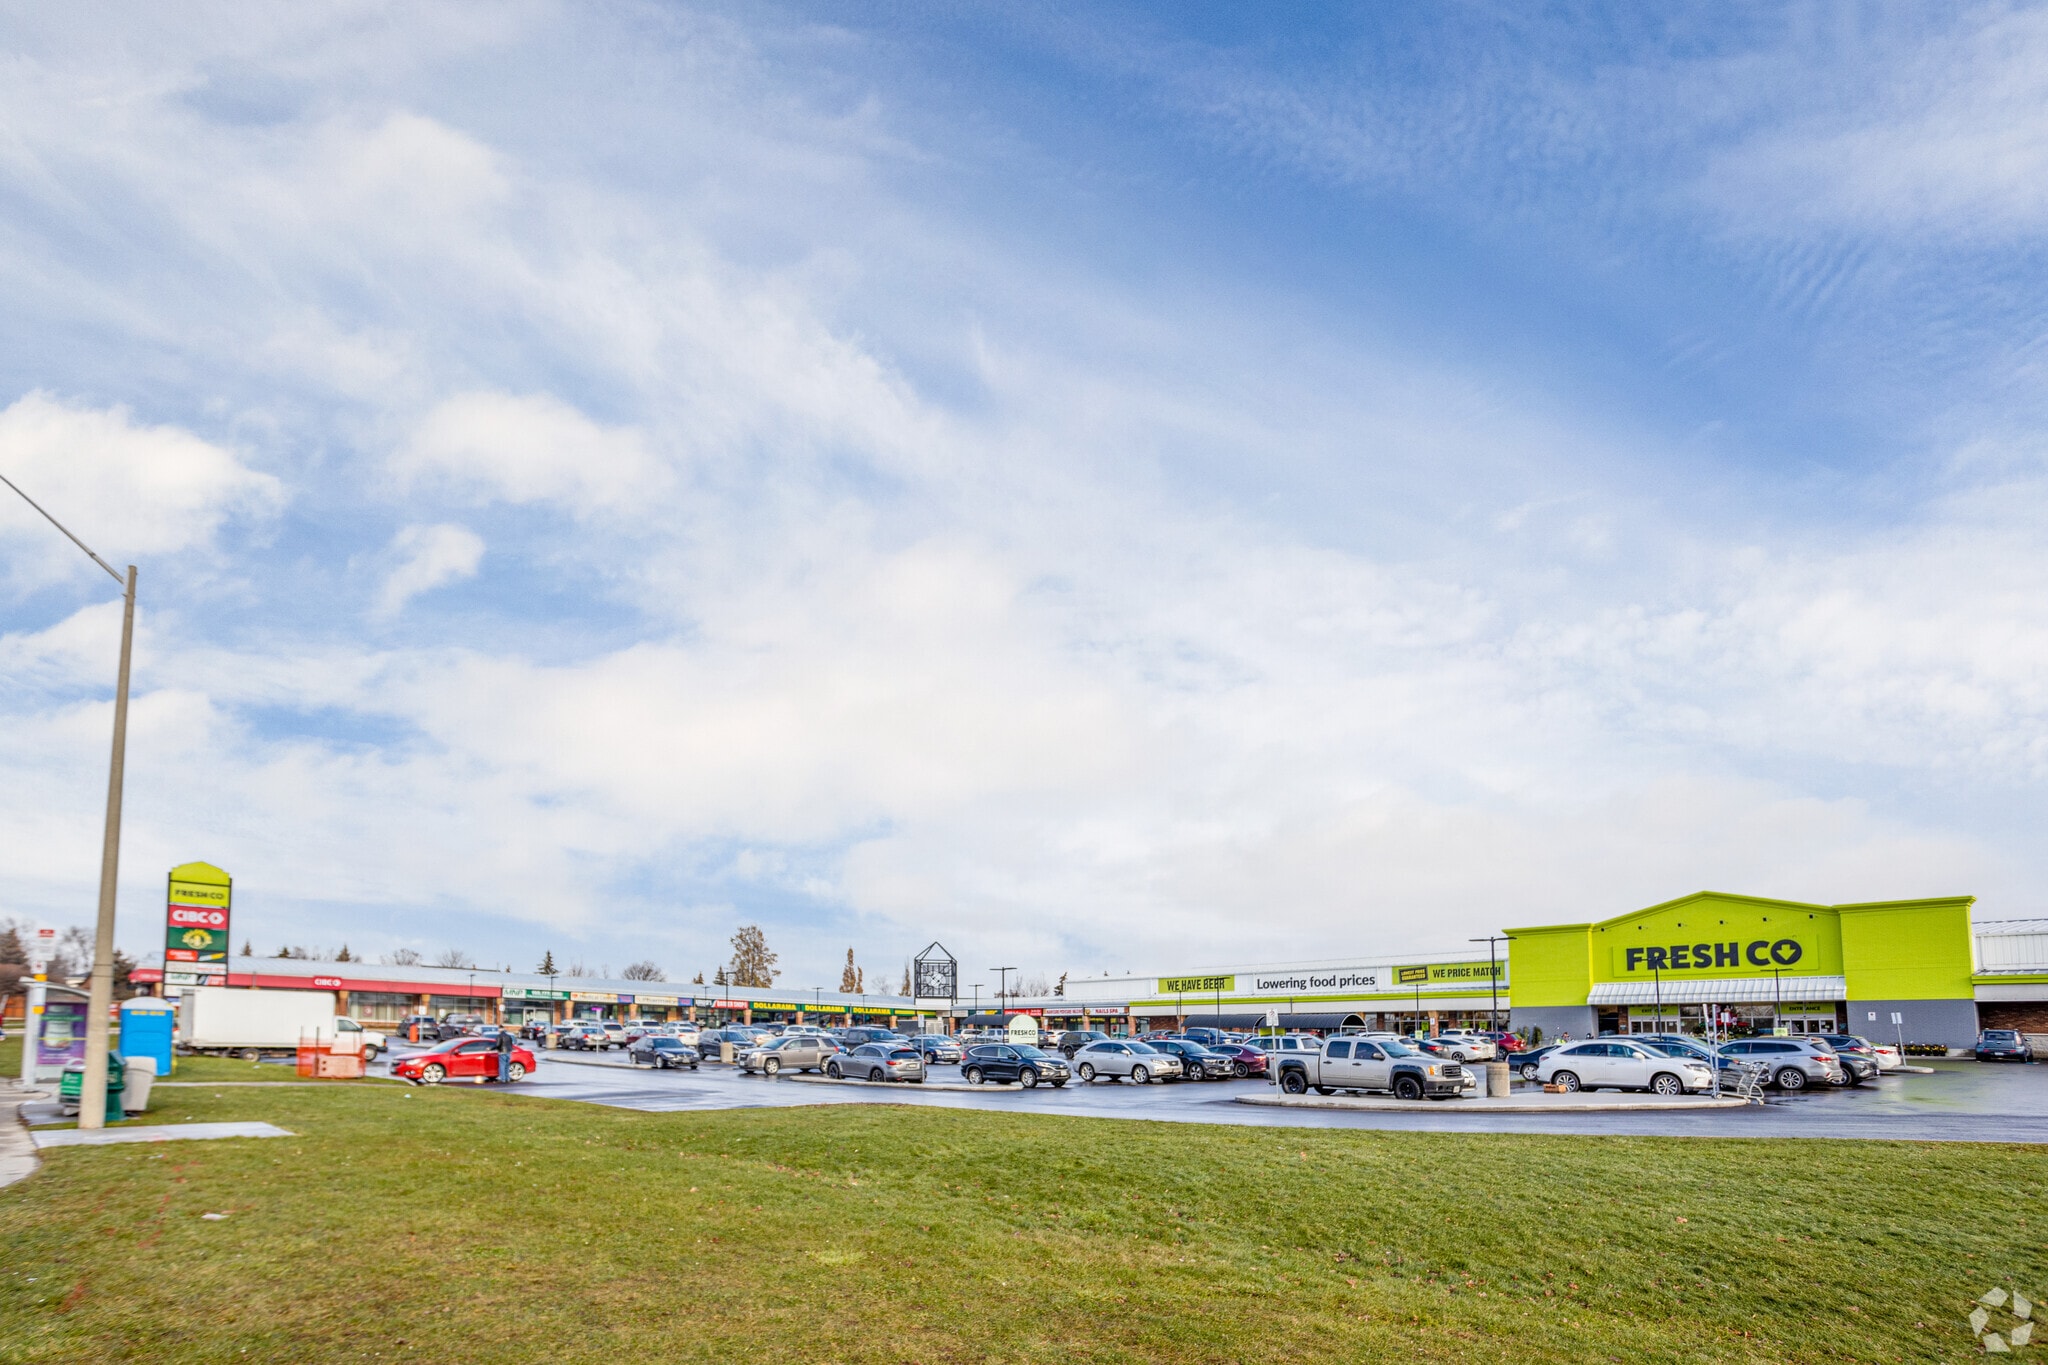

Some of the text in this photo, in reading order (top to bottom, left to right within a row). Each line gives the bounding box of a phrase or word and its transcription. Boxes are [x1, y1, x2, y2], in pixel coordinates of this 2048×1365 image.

[174, 889, 224, 900] FRESH CO
[172, 909, 209, 924] CIBC
[1626, 939, 1802, 971] FRESH CO
[1432, 969, 1446, 978] WE
[1447, 968, 1471, 978] PRICE
[314, 978, 334, 987] CIBC
[1167, 978, 1225, 991] WE HAVE BEER
[1257, 974, 1375, 990] Lowering food prices
[753, 1002, 797, 1011] DOLLARAMA
[804, 1004, 846, 1013] DOLLARAMA
